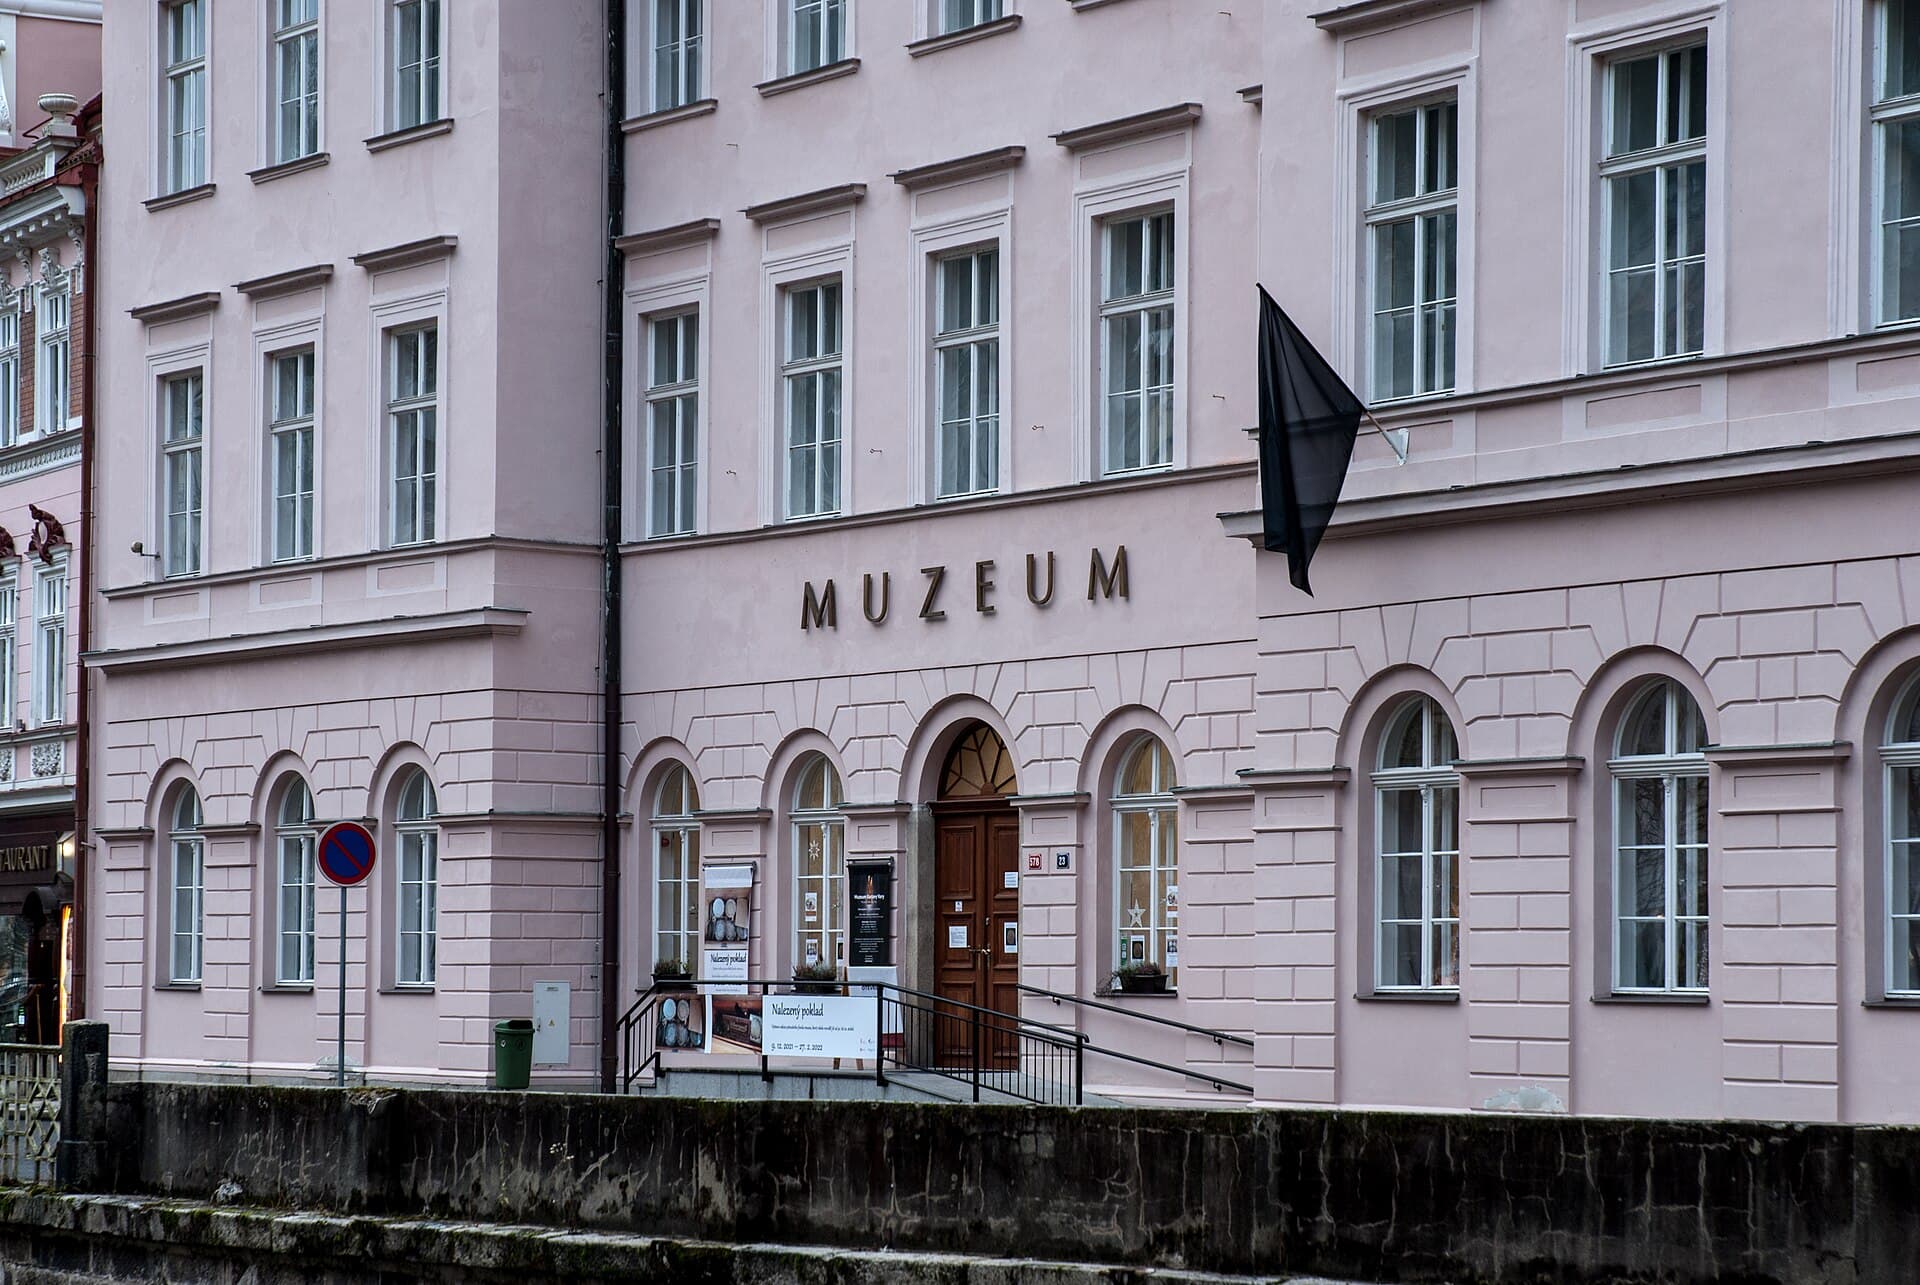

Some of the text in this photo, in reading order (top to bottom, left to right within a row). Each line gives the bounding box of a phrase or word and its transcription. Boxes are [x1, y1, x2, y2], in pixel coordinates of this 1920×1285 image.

[801, 545, 1129, 630] MUZEUM
[1058, 856, 1066, 866] 23
[771, 1002, 824, 1020] Nalezený poklad
